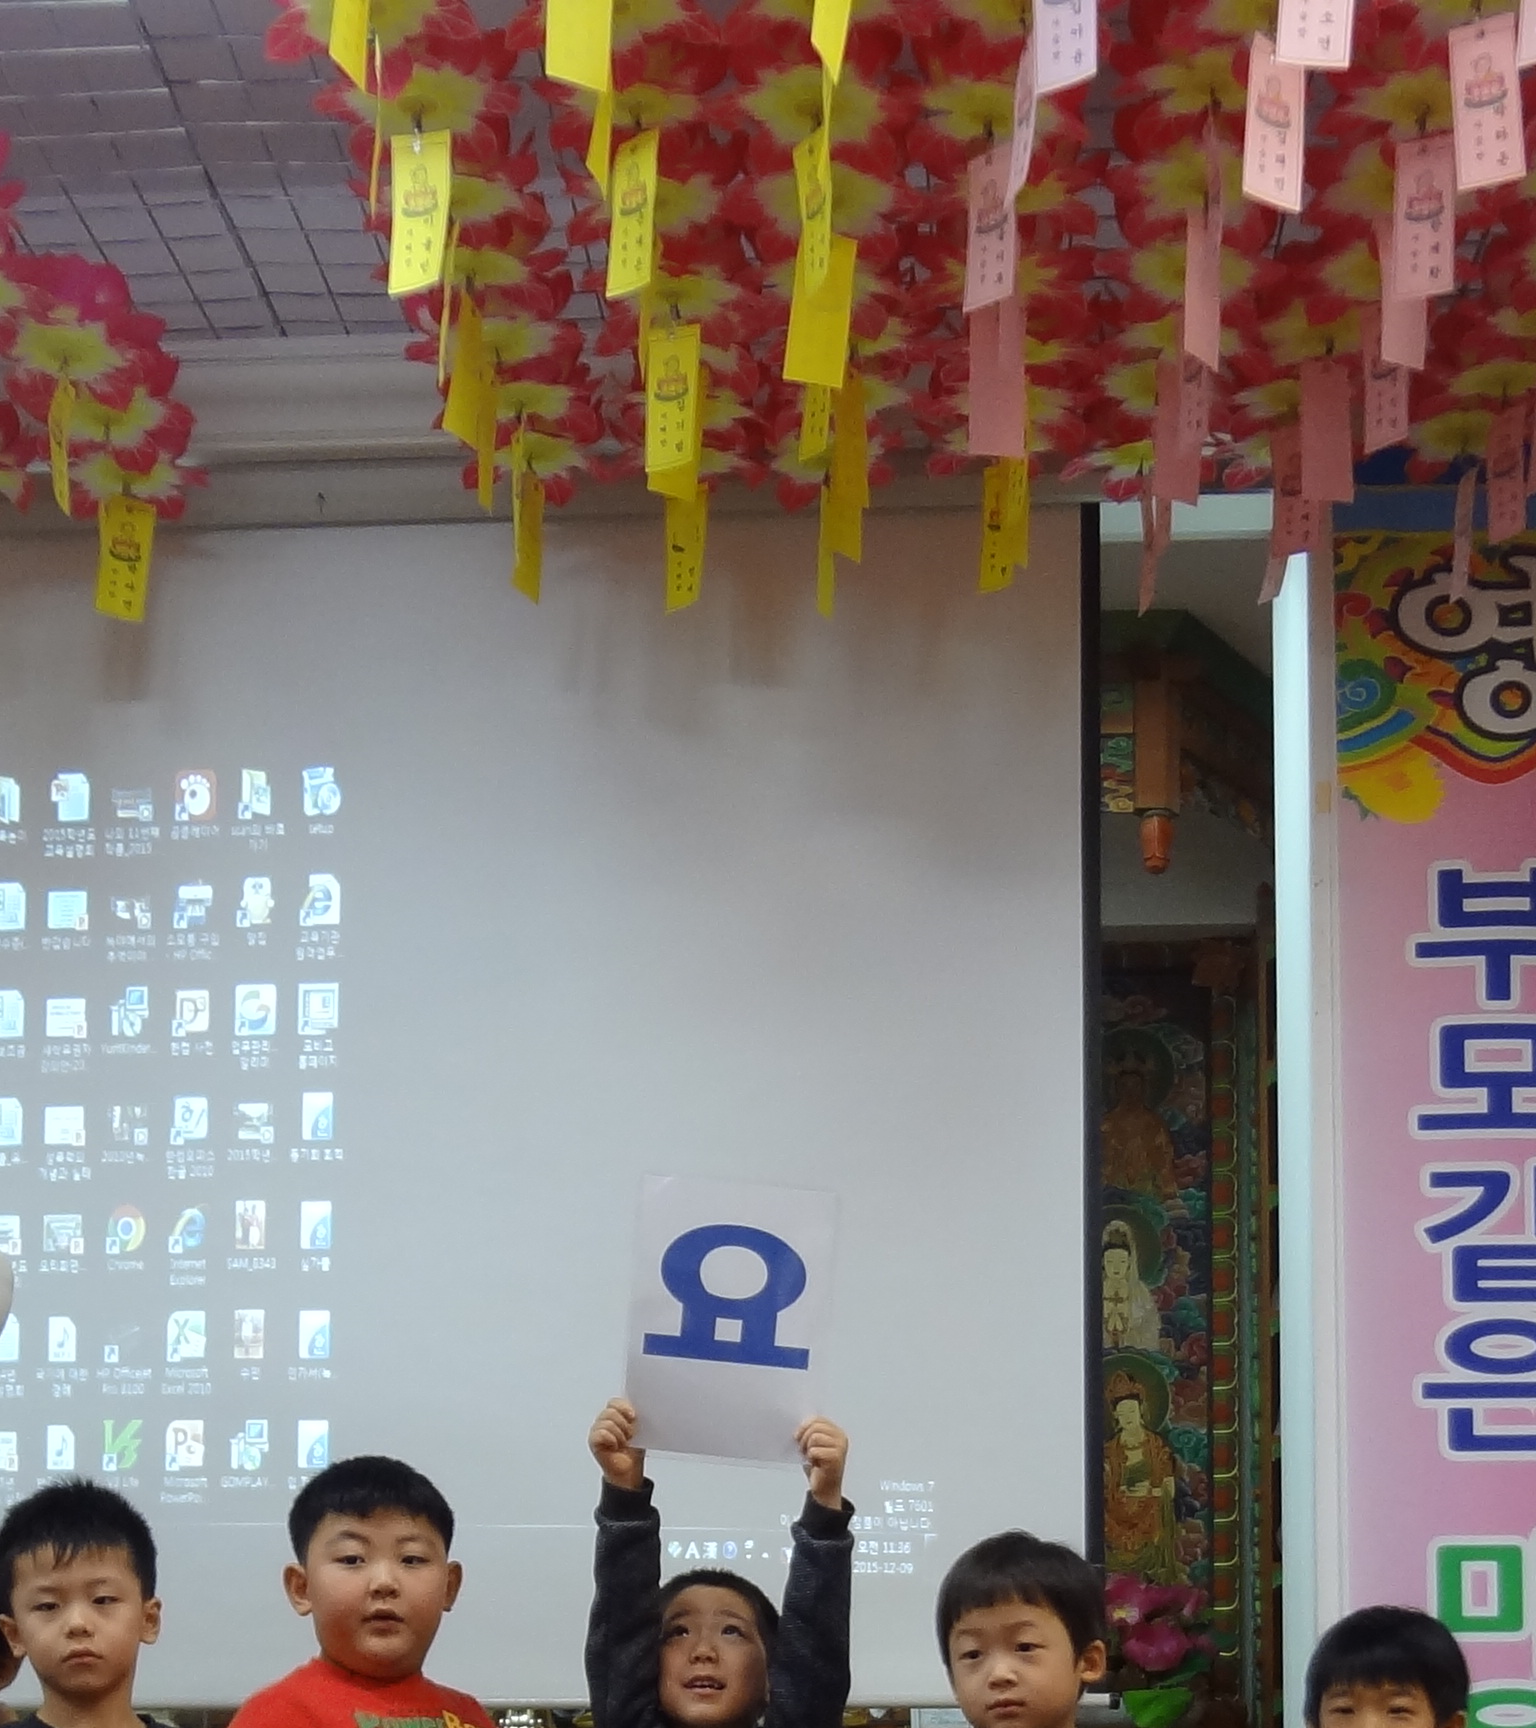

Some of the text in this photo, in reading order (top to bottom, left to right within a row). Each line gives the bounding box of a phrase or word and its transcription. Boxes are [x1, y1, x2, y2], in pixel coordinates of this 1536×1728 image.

[643, 1223, 809, 1371] 요
[165, 1366, 209, 1380] Microsoft
[879, 1479, 925, 1493] Windows
[857, 1540, 912, 1555] 오전 11:36
[852, 1560, 914, 1575] 2015-12-09
